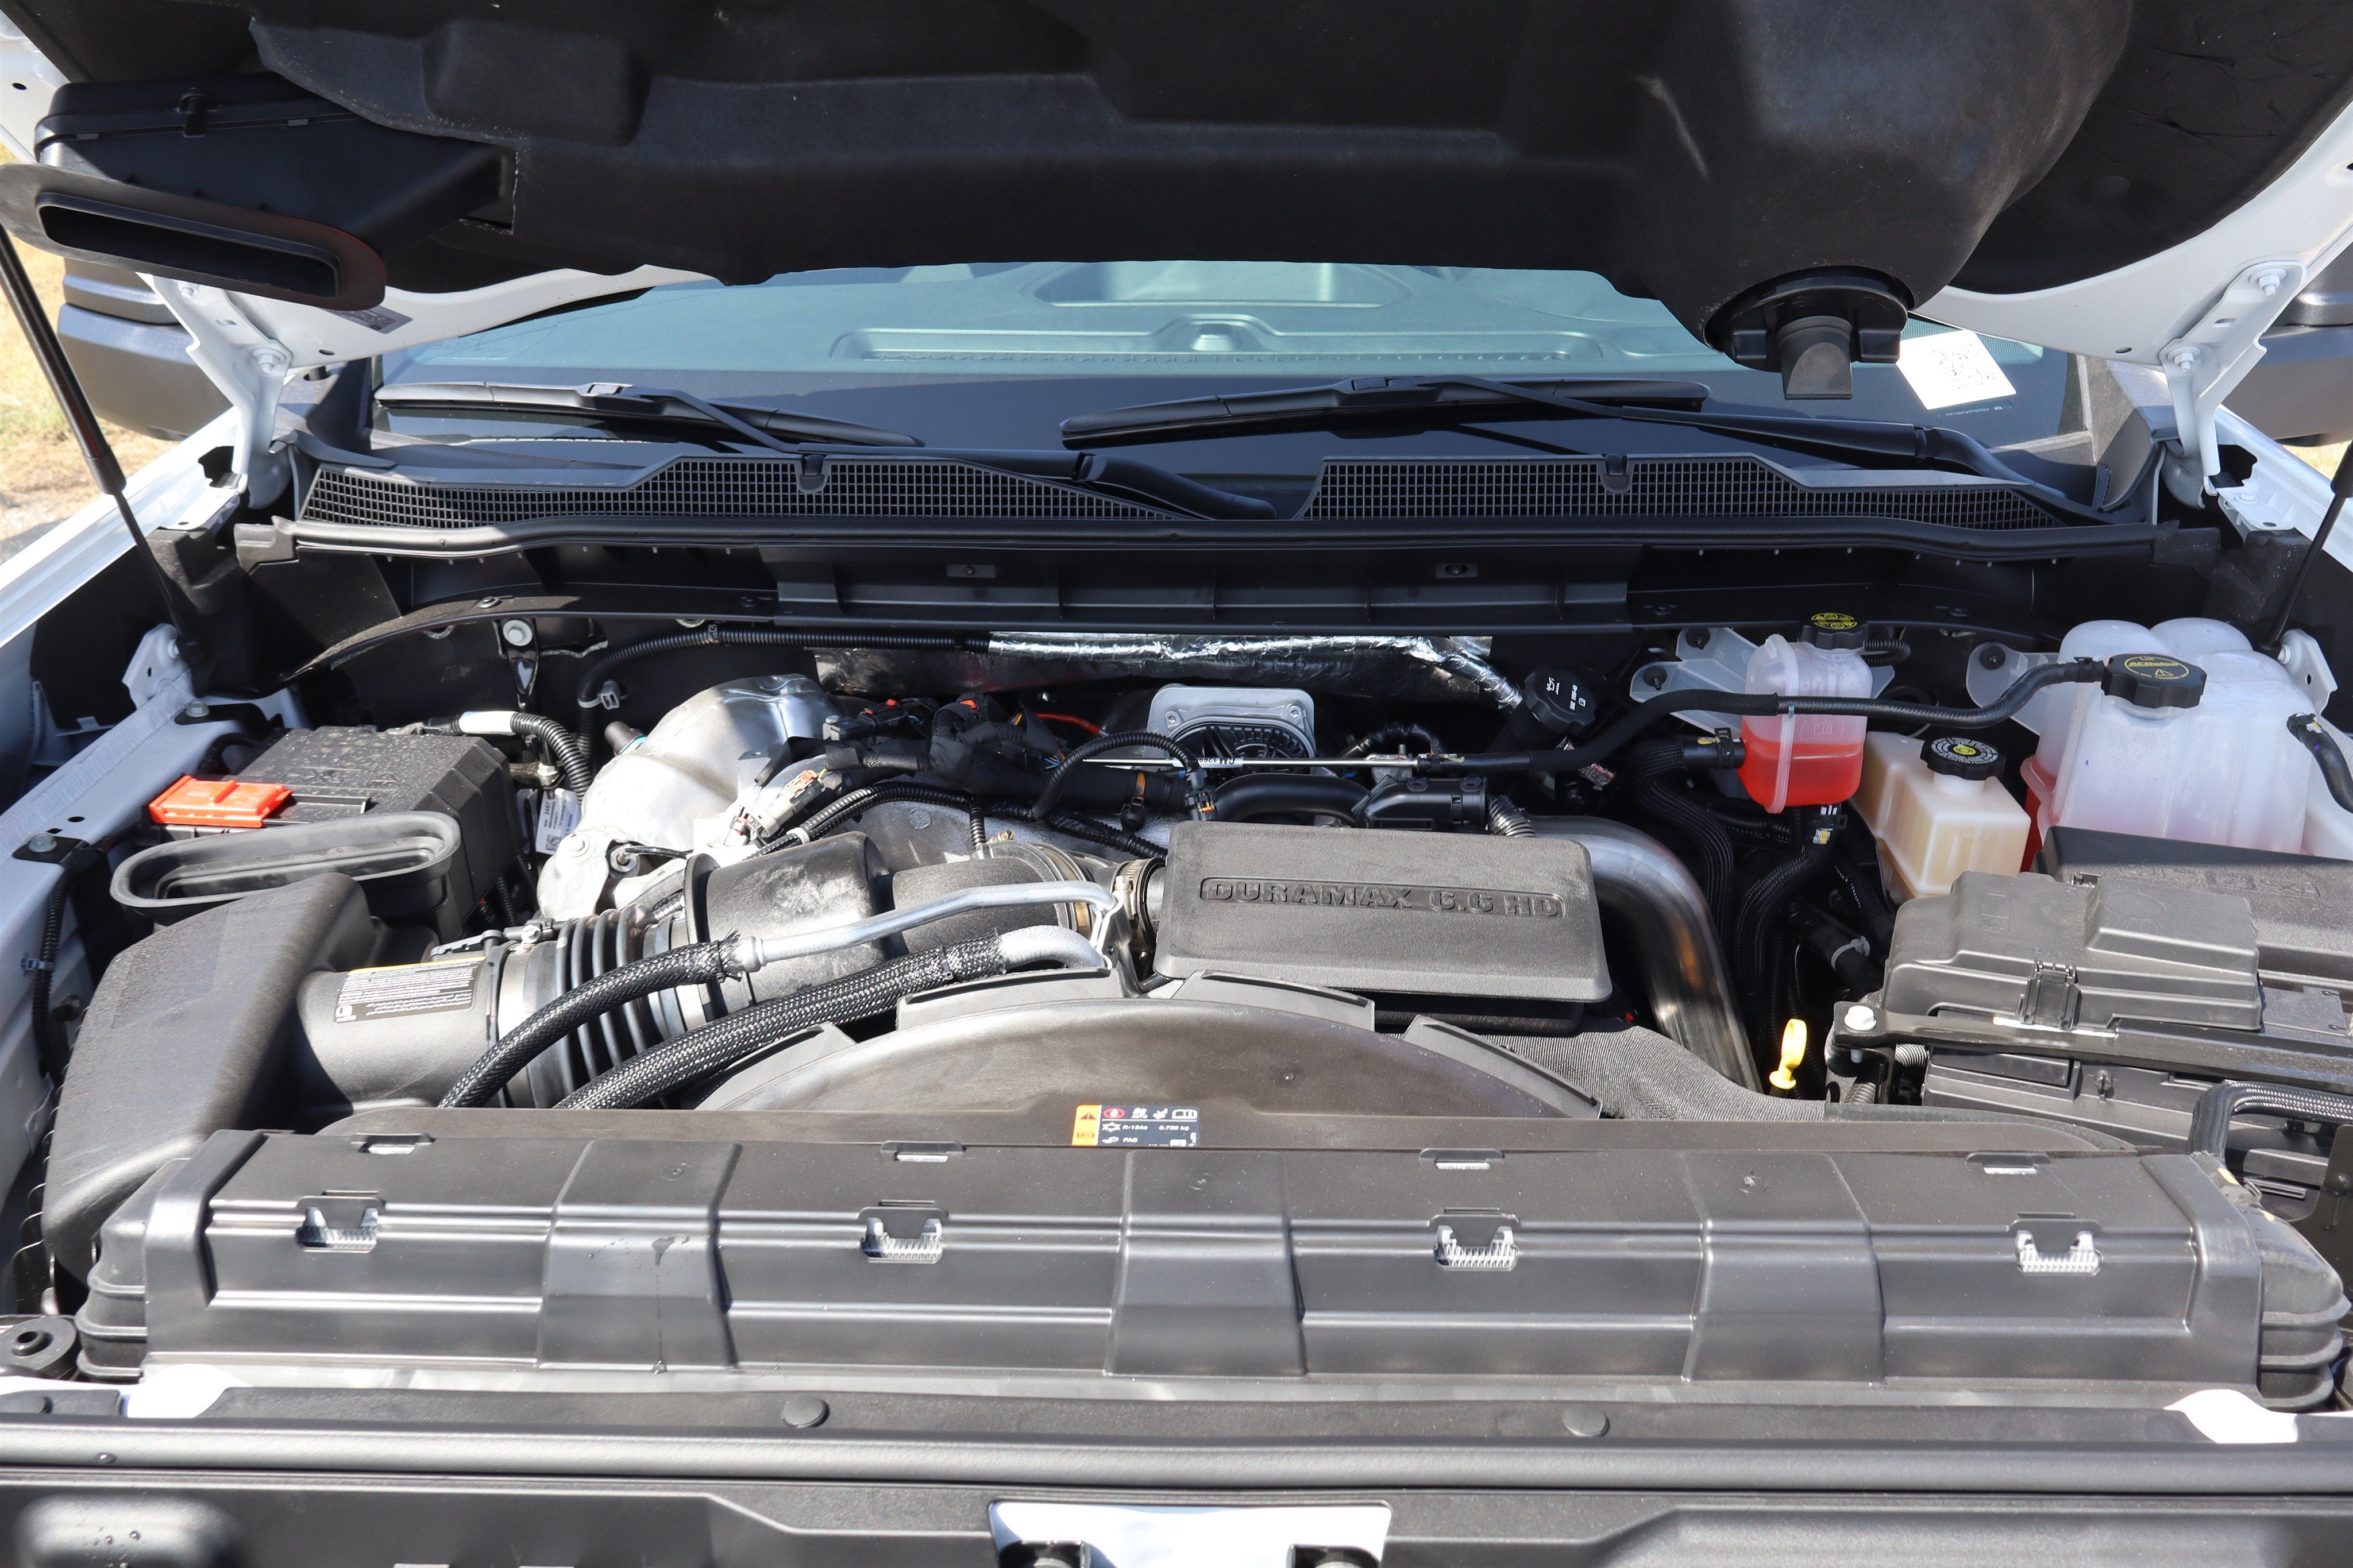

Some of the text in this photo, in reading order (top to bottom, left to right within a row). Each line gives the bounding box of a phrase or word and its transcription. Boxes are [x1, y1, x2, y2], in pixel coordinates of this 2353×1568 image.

[1206, 882, 1559, 918] DURAMAX 6.6 HD
